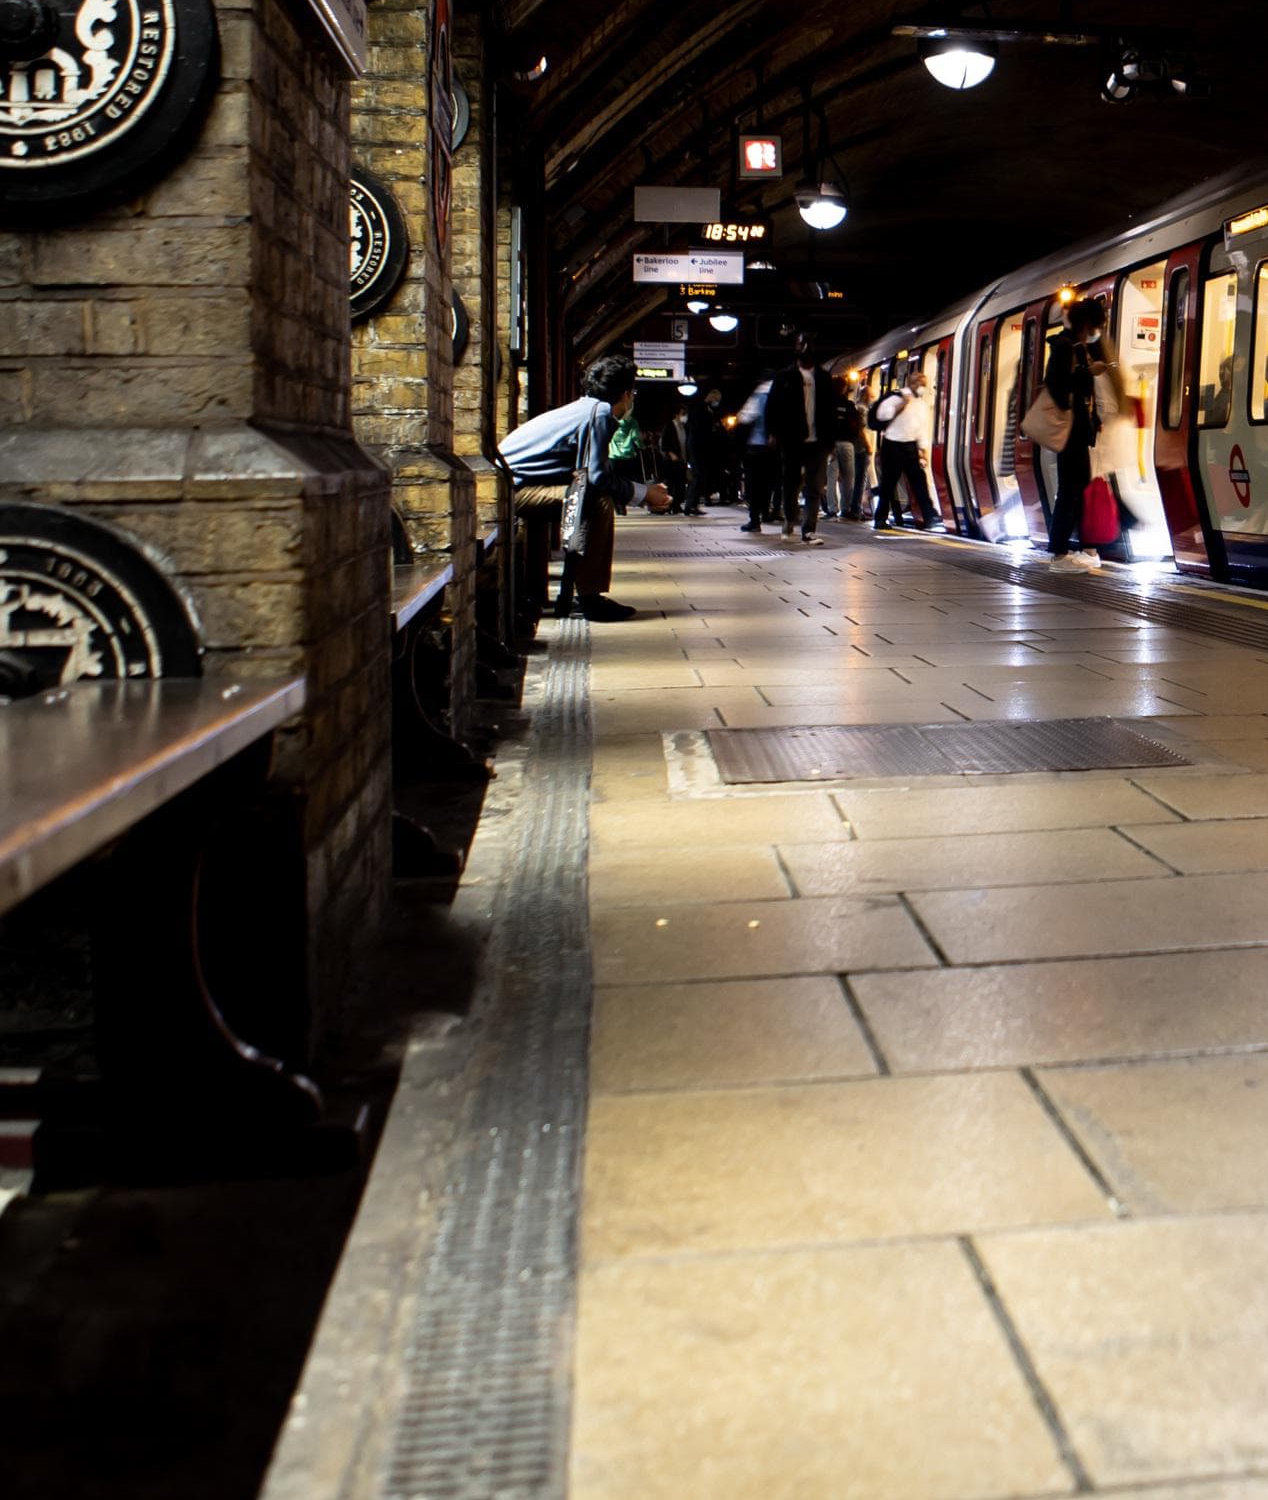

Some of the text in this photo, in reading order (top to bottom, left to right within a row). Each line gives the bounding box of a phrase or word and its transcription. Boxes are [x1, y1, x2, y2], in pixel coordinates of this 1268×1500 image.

[104, 10, 160, 119] RESTORED
[43, 121, 97, 151] 1983
[356, 232, 382, 285] RESTORED
[644, 256, 679, 265] Bakerloo
[700, 258, 728, 266] Jubilee
